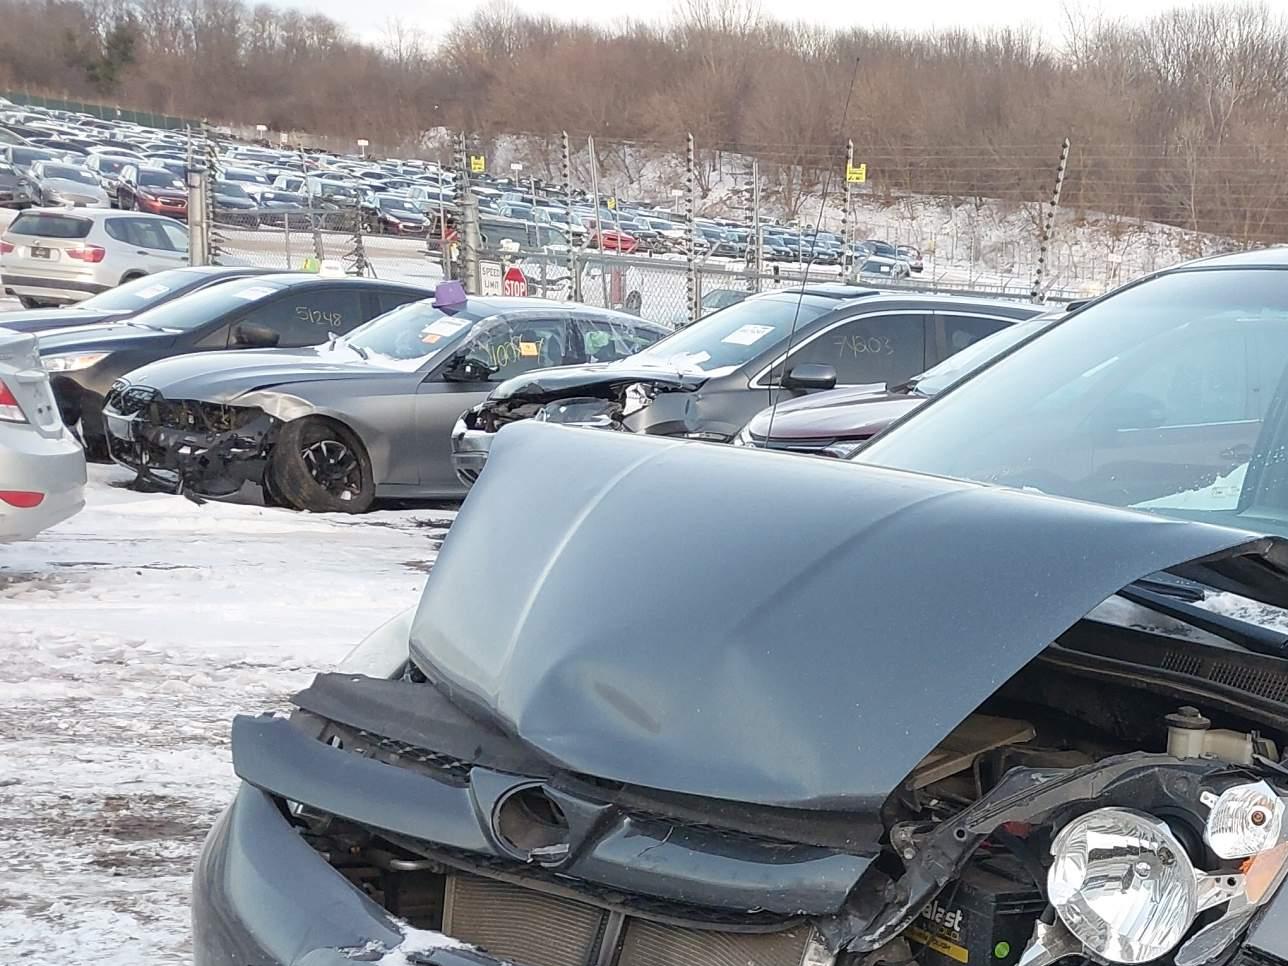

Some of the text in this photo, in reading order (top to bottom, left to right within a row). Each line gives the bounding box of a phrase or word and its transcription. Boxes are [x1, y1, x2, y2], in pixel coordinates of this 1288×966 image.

[482, 267, 500, 277] SPEED
[484, 280, 499, 288] LIMIT
[504, 281, 525, 296] STOP
[295, 306, 342, 327] 51248
[833, 335, 894, 360] 74203
